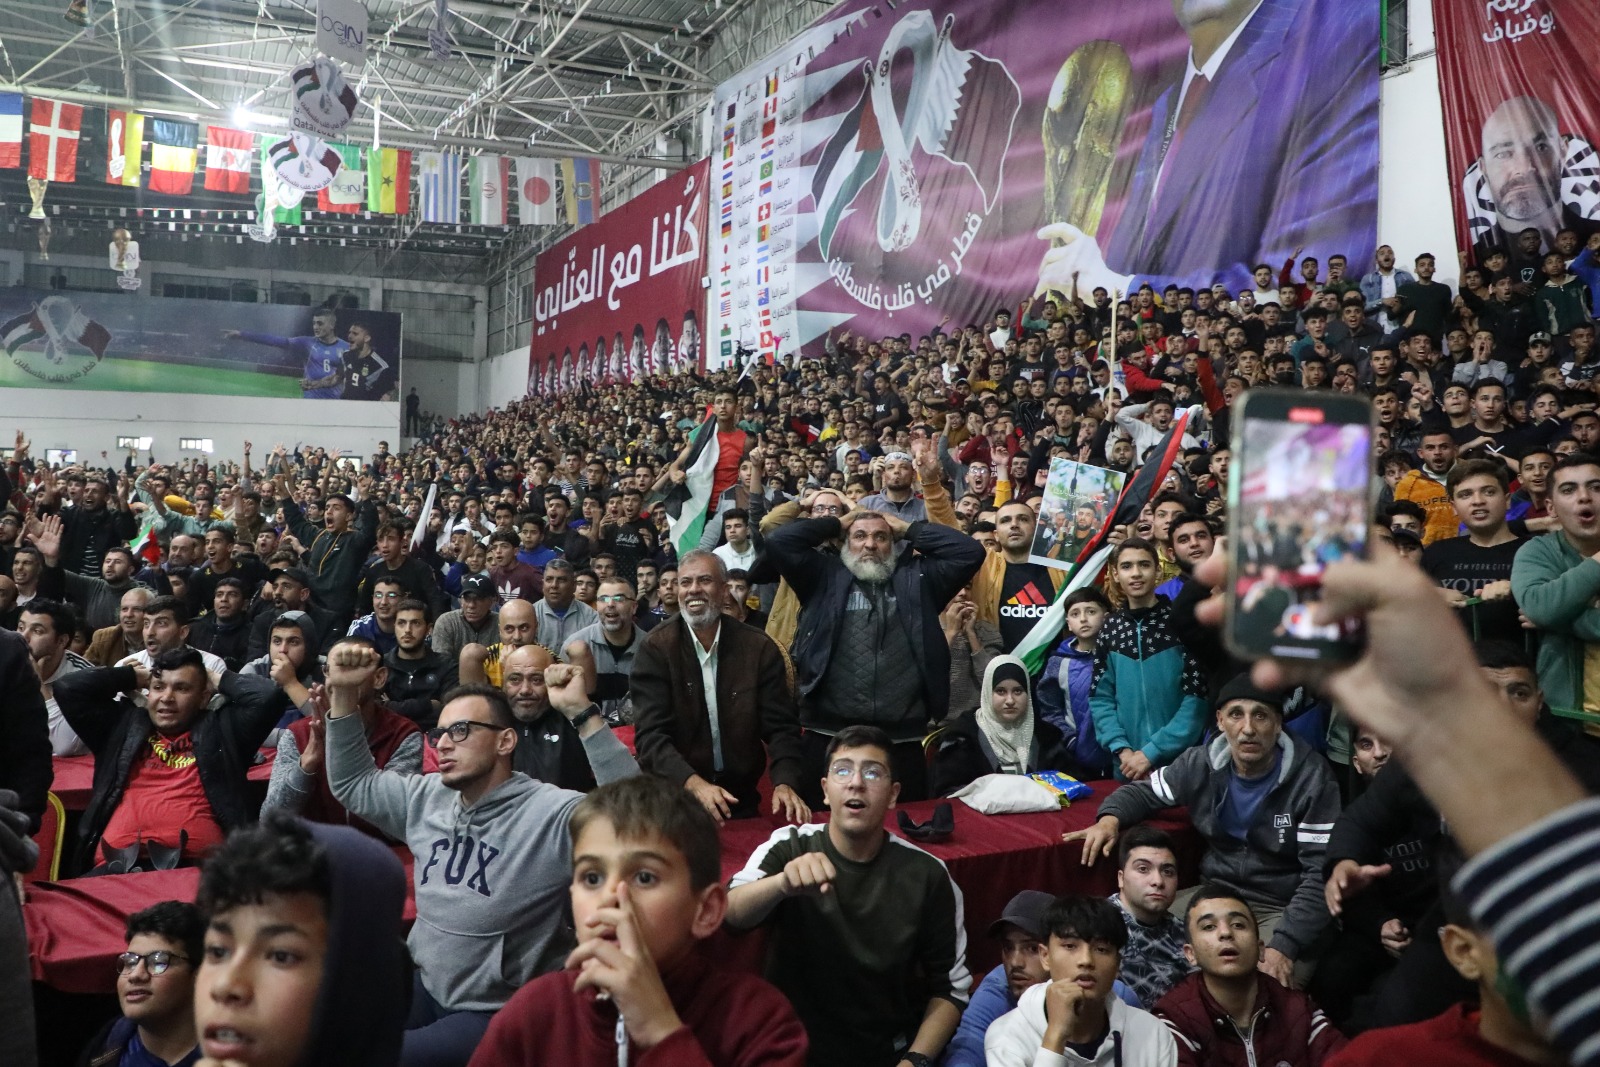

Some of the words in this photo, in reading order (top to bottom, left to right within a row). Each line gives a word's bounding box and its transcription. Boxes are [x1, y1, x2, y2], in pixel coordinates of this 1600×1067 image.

[321, 9, 363, 45] beIN
[1483, 11, 1556, 42] بوضياف
[951, 211, 983, 276] قطر
[607, 243, 642, 311] مع
[829, 256, 882, 311] فلسطين
[917, 258, 951, 305] في
[883, 281, 916, 318] قلب
[323, 358, 331, 373] 6
[351, 372, 360, 387] 9
[1454, 563, 1469, 571] NEW
[1470, 563, 1490, 571] YORK
[1001, 603, 1050, 618] adida
[420, 835, 500, 897] FOX
